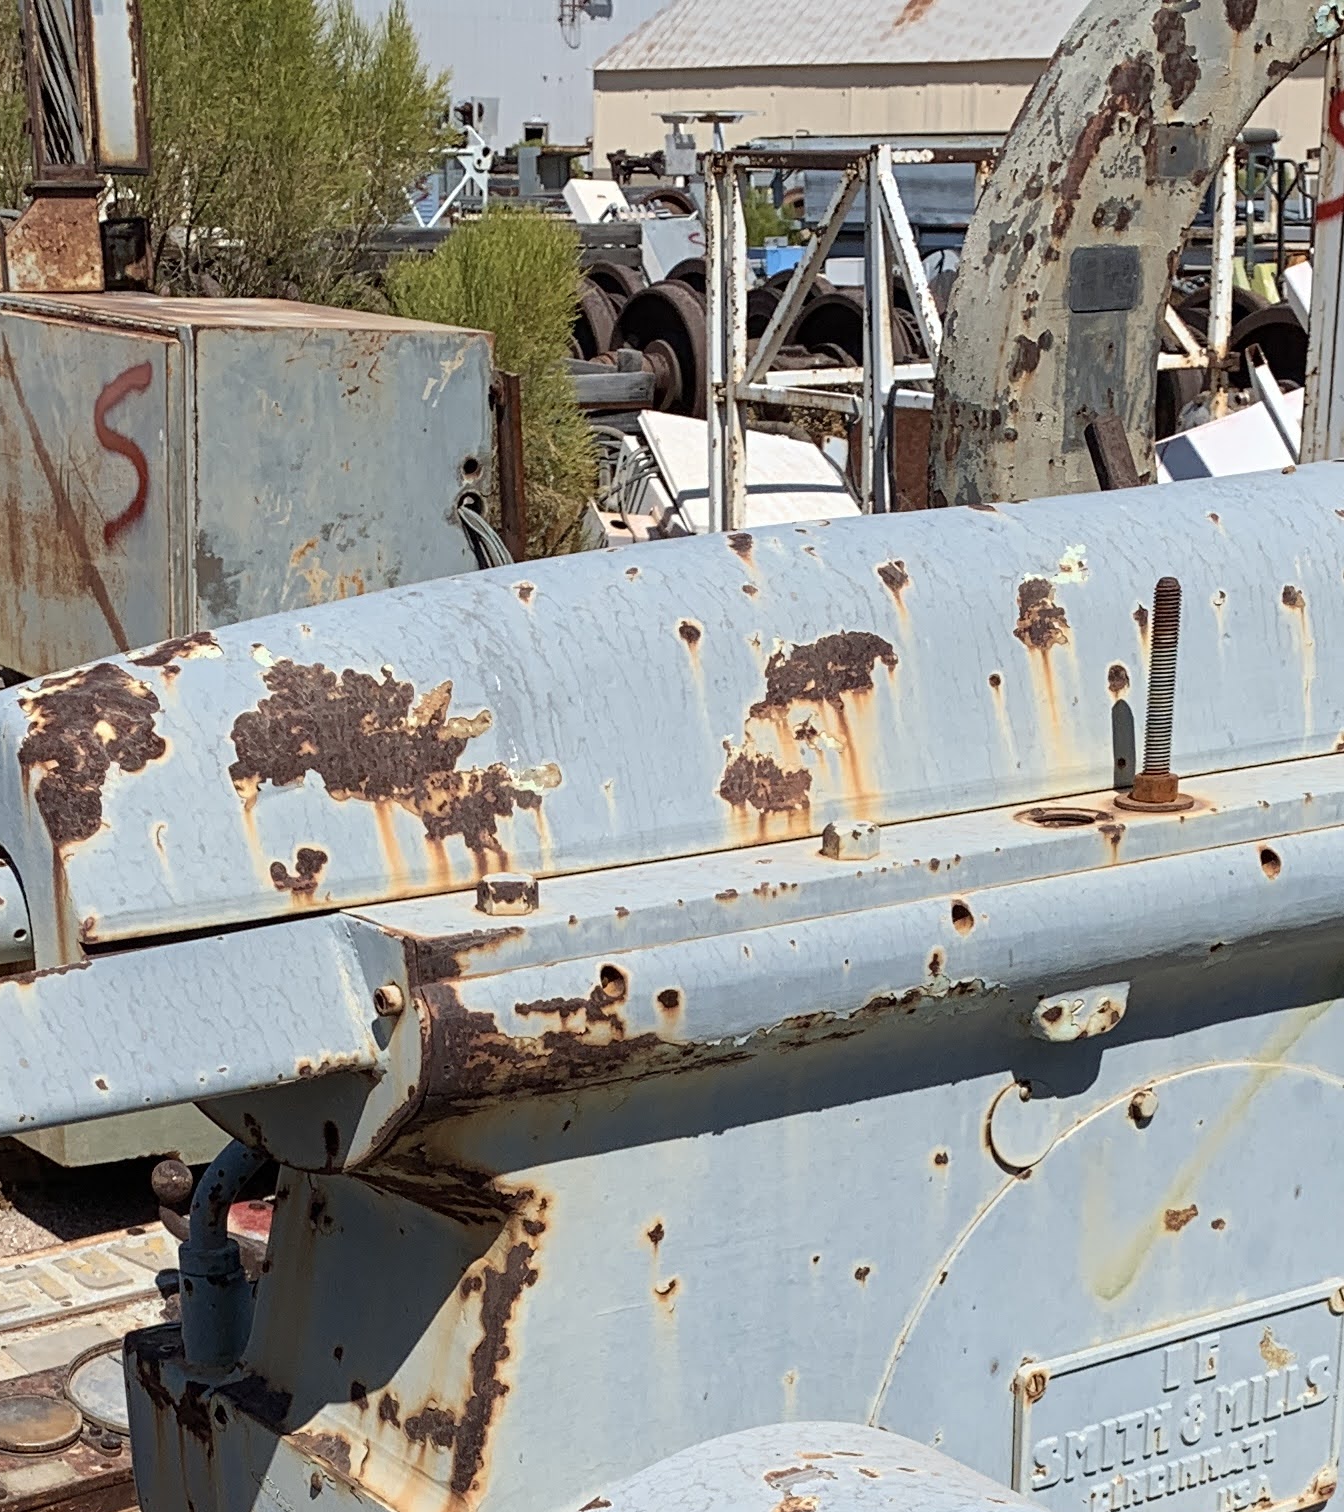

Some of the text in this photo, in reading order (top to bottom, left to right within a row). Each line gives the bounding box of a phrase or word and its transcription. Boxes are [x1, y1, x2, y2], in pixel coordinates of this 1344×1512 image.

[93, 361, 153, 545] S
[1031, 1355, 1332, 1492] SMITH & MILLS
